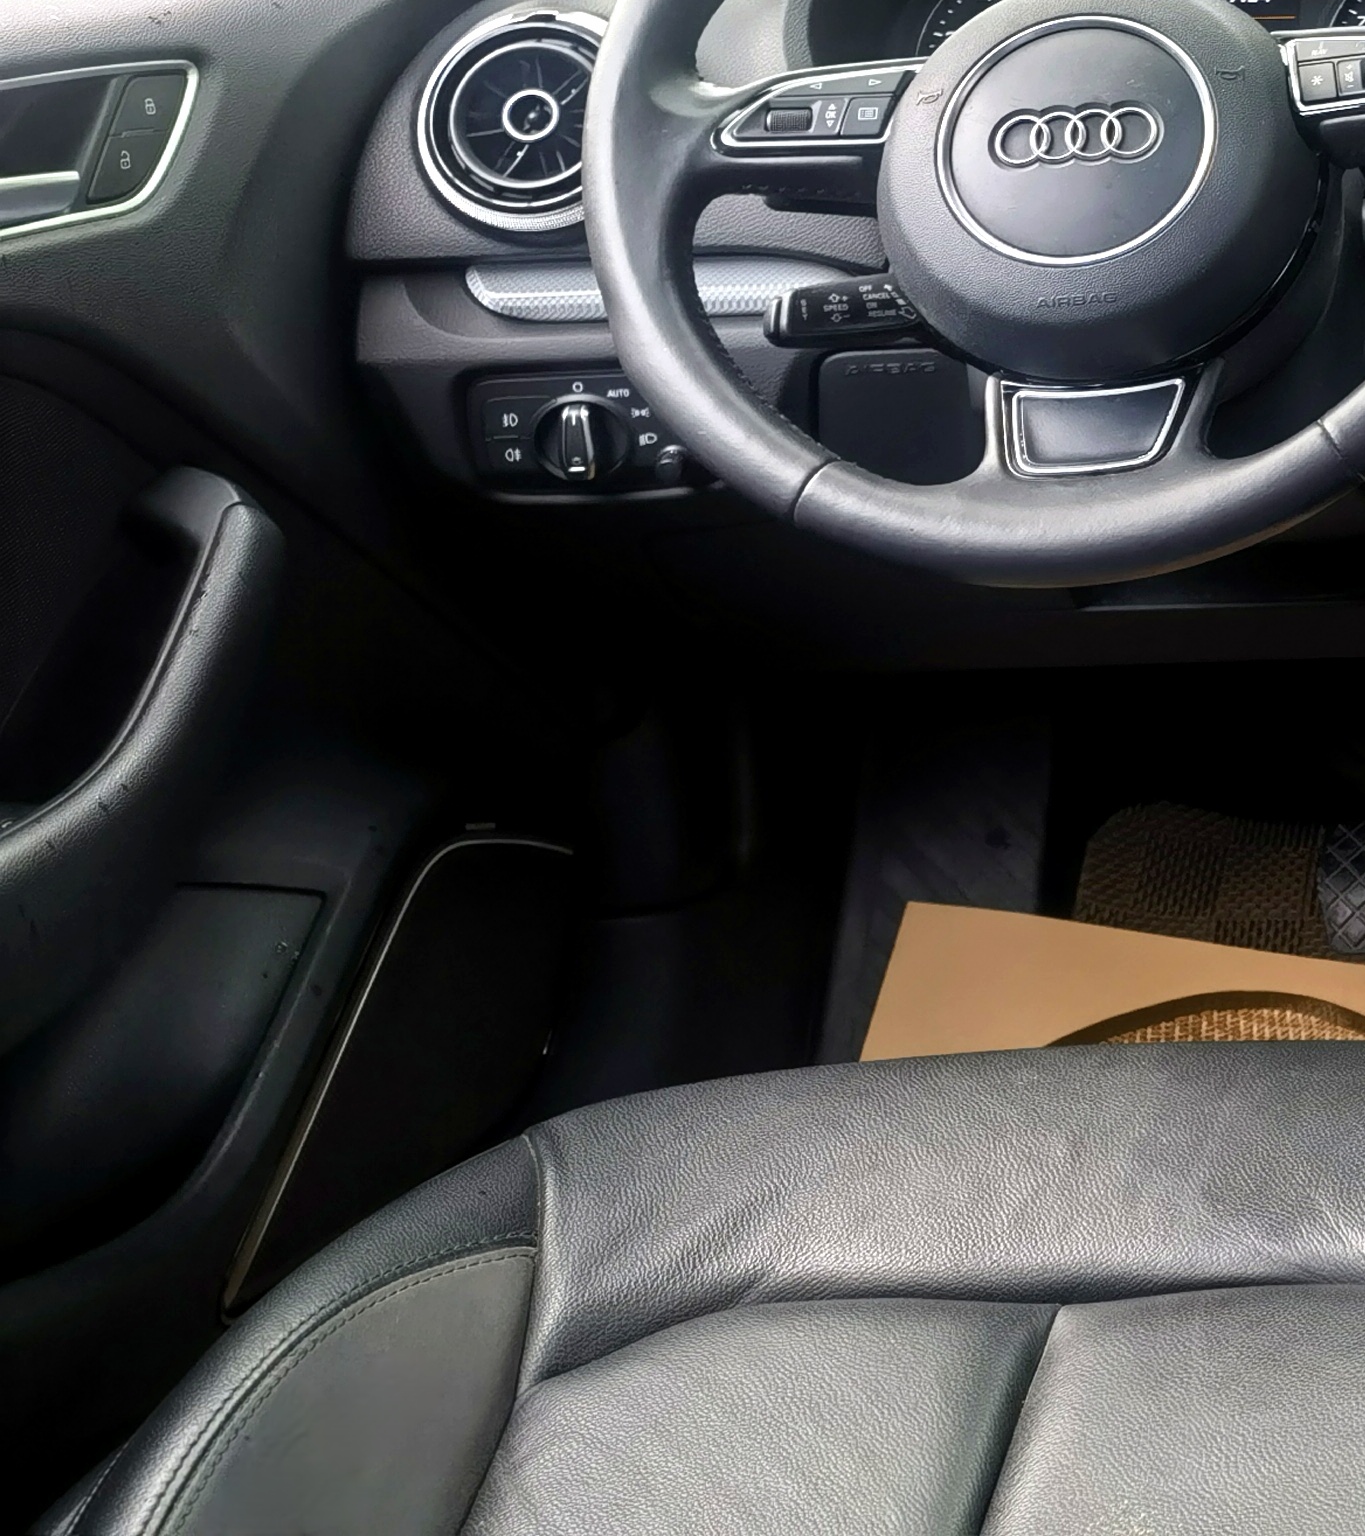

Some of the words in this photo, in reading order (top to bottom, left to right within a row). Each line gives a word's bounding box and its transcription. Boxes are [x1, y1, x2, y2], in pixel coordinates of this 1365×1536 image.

[824, 110, 837, 119] OK
[859, 285, 873, 293] OFF
[862, 292, 890, 301] CANCEL
[1036, 292, 1118, 308] AIRBAG
[823, 303, 849, 312] SPEED
[606, 388, 630, 398] AUTO
